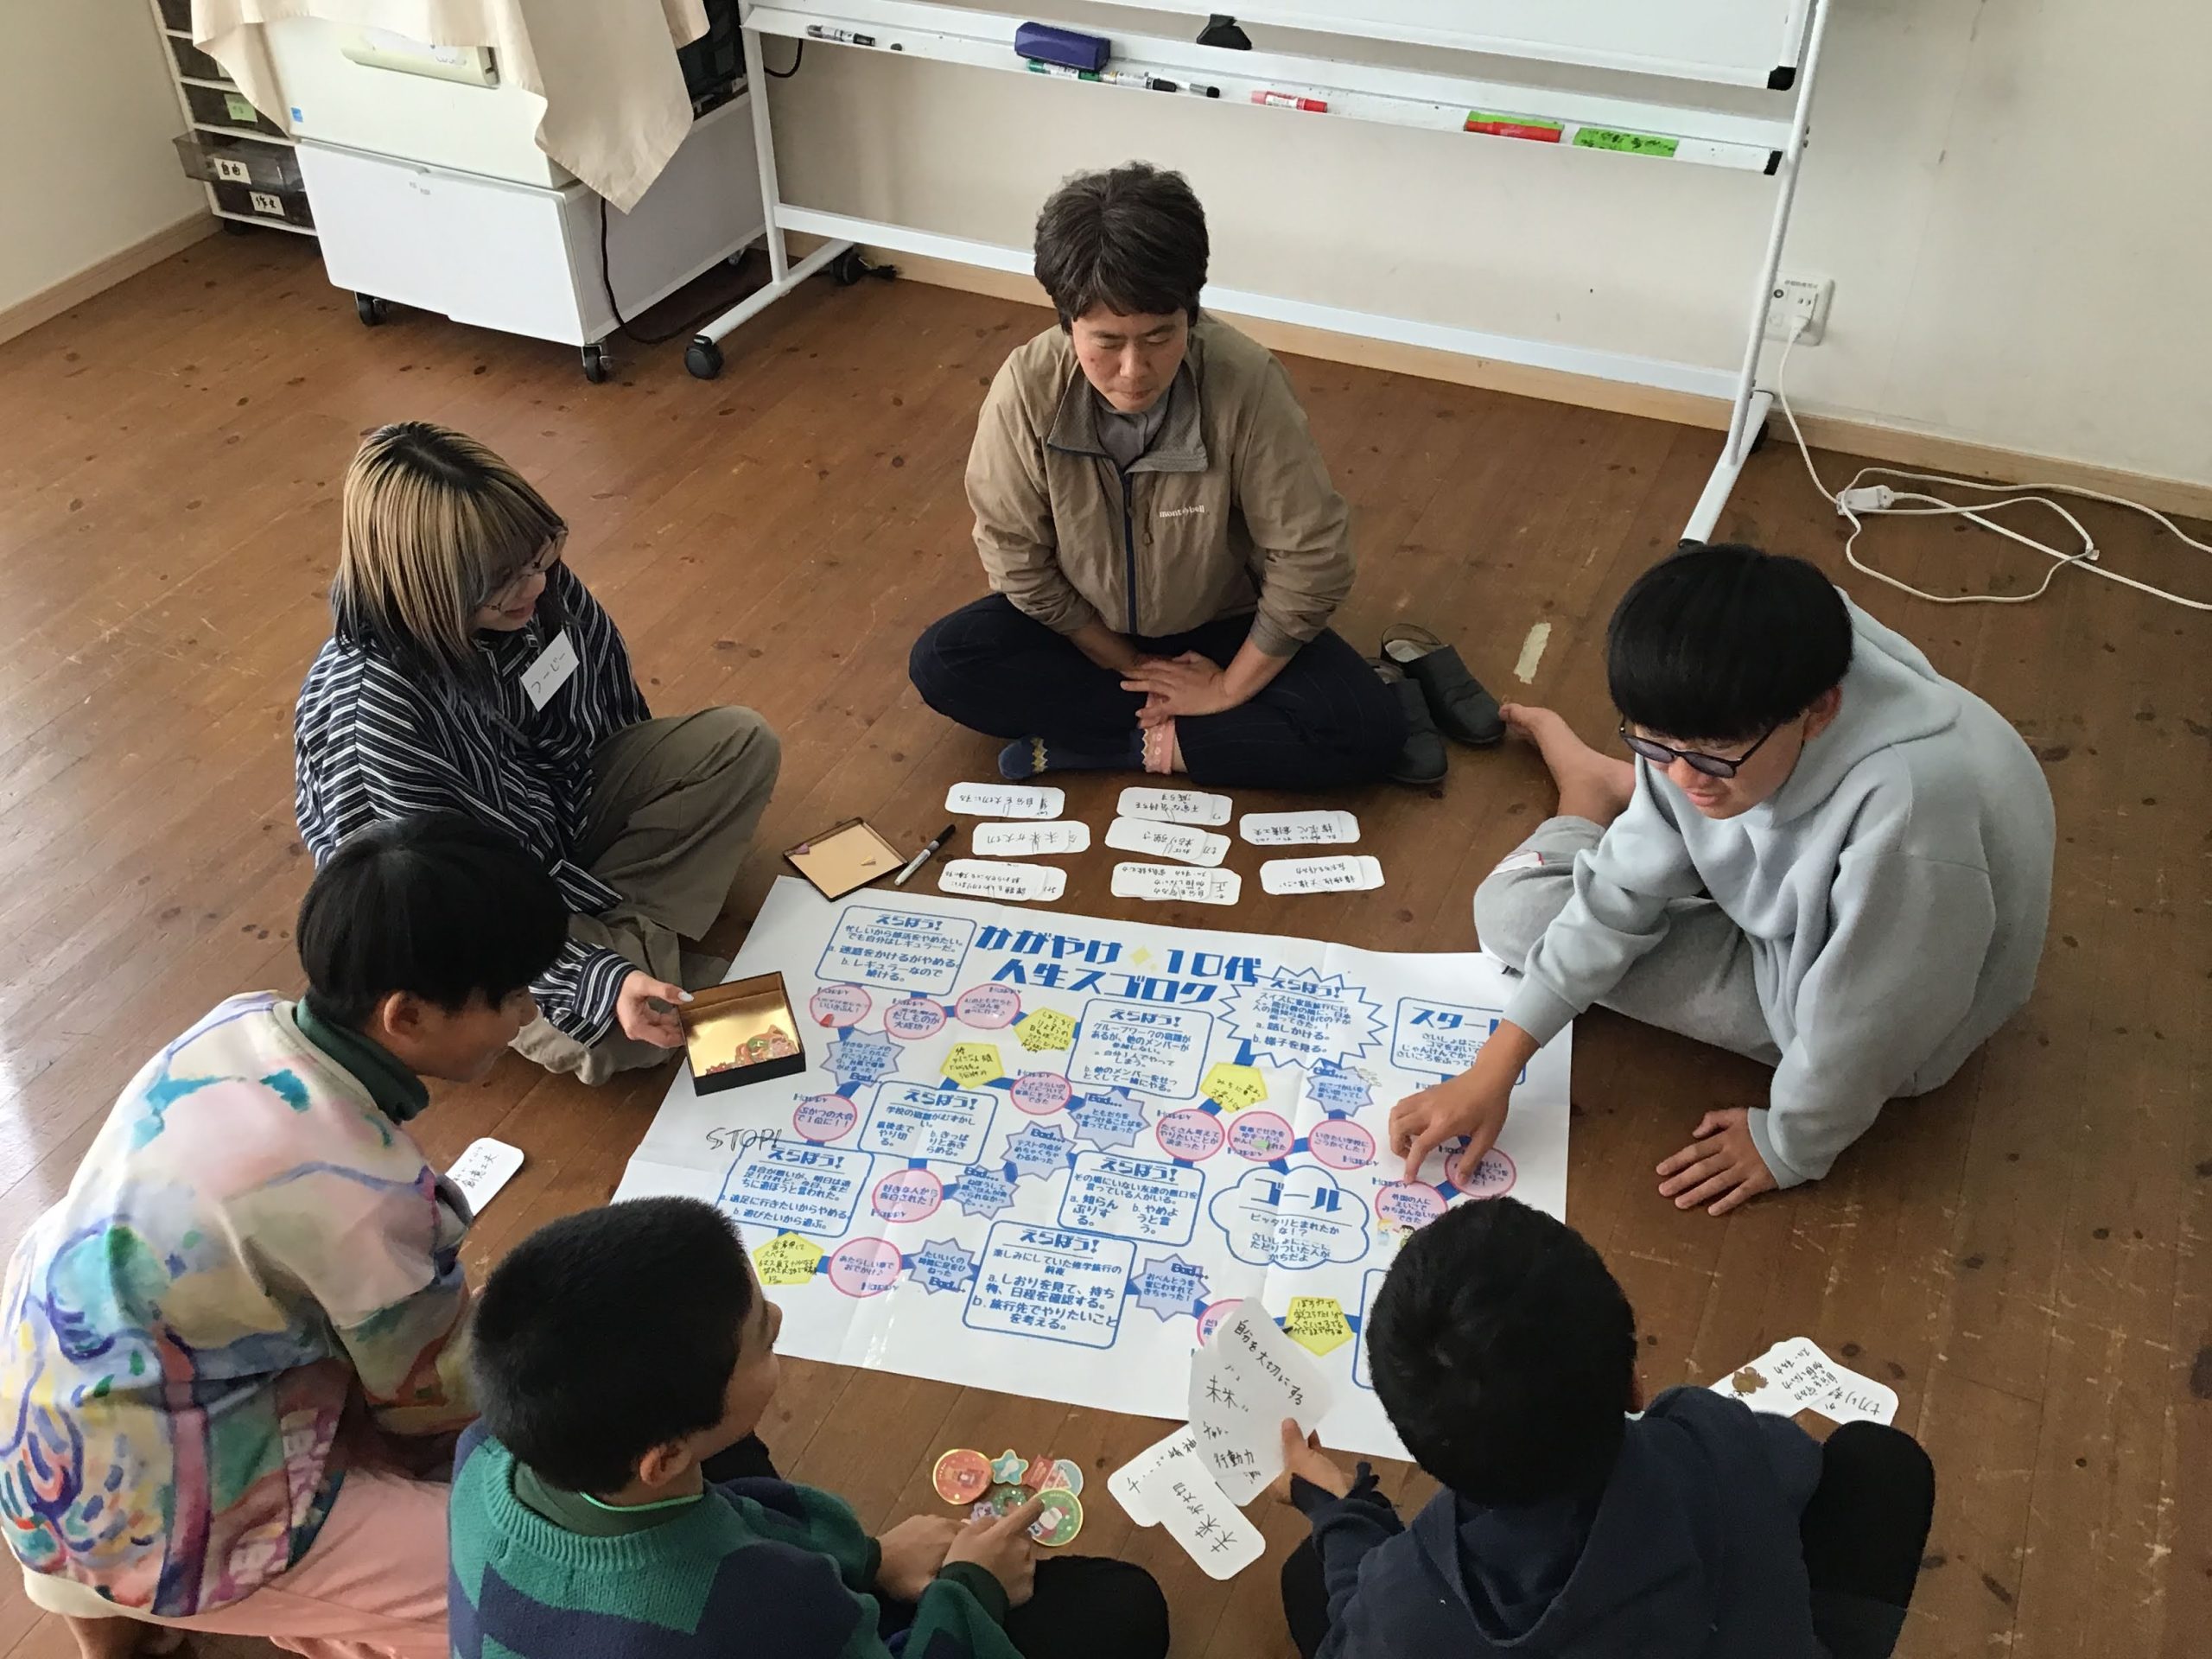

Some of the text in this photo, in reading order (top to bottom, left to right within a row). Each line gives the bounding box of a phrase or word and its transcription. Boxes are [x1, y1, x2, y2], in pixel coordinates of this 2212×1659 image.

[876, 914, 944, 931] えらぼう！
[975, 925, 1262, 987] かがやけ 10代
[854, 959, 944, 977] レギュラーなので
[991, 958, 1217, 1004] 人生スゴロク
[1270, 978, 1340, 998] えらぼう！
[1109, 1008, 1181, 1027] えらぼう！
[1267, 1022, 1330, 1041] 話しかける。
[1264, 1035, 1327, 1053] 様子を見る。
[904, 1089, 978, 1110] えらぼう！
[706, 1127, 782, 1152] STOP!
[768, 1147, 844, 1168] えらぼう！
[1101, 1157, 1178, 1182] えらぼう！
[1251, 1179, 1343, 1212] ゴール
[1077, 1215, 1095, 1227] る。
[1145, 1205, 1179, 1217] やめよ
[1020, 1229, 1100, 1253] えらぼう！
[985, 1283, 1105, 1310] 物、日程を確認する。
[1002, 1273, 1116, 1299] しおりを見て、持ち
[989, 1299, 1118, 1328] 旅行先でやりたいこと
[1010, 1313, 1066, 1331] を考える。
[1234, 1319, 1304, 1406] 自分を大切にする
[1173, 1482, 1238, 1553] 未来が大切
